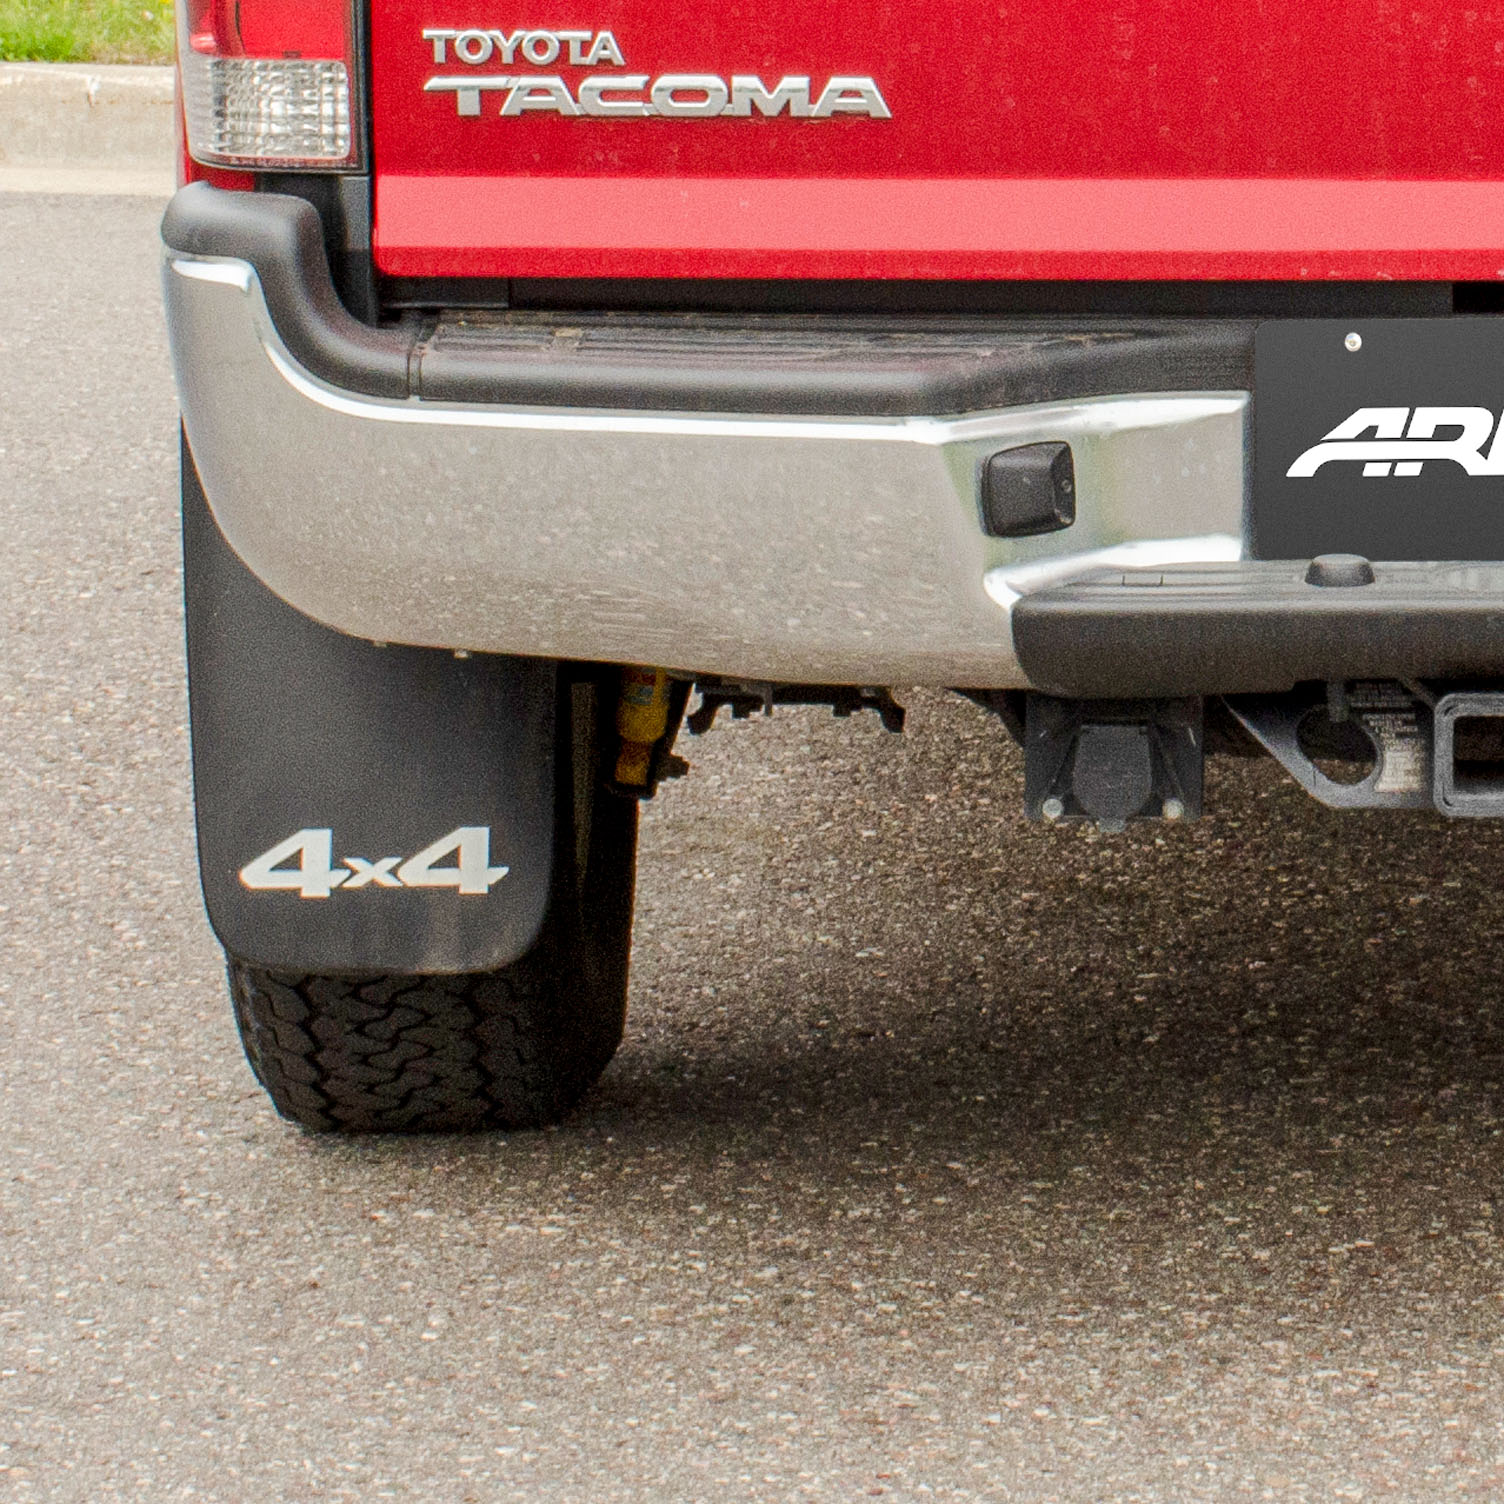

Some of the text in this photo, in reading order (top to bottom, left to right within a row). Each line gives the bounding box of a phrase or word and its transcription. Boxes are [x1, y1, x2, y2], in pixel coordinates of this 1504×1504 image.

[422, 27, 626, 67] TOYOTA
[423, 74, 893, 120] TACOMA
[238, 825, 511, 898] 4x4
